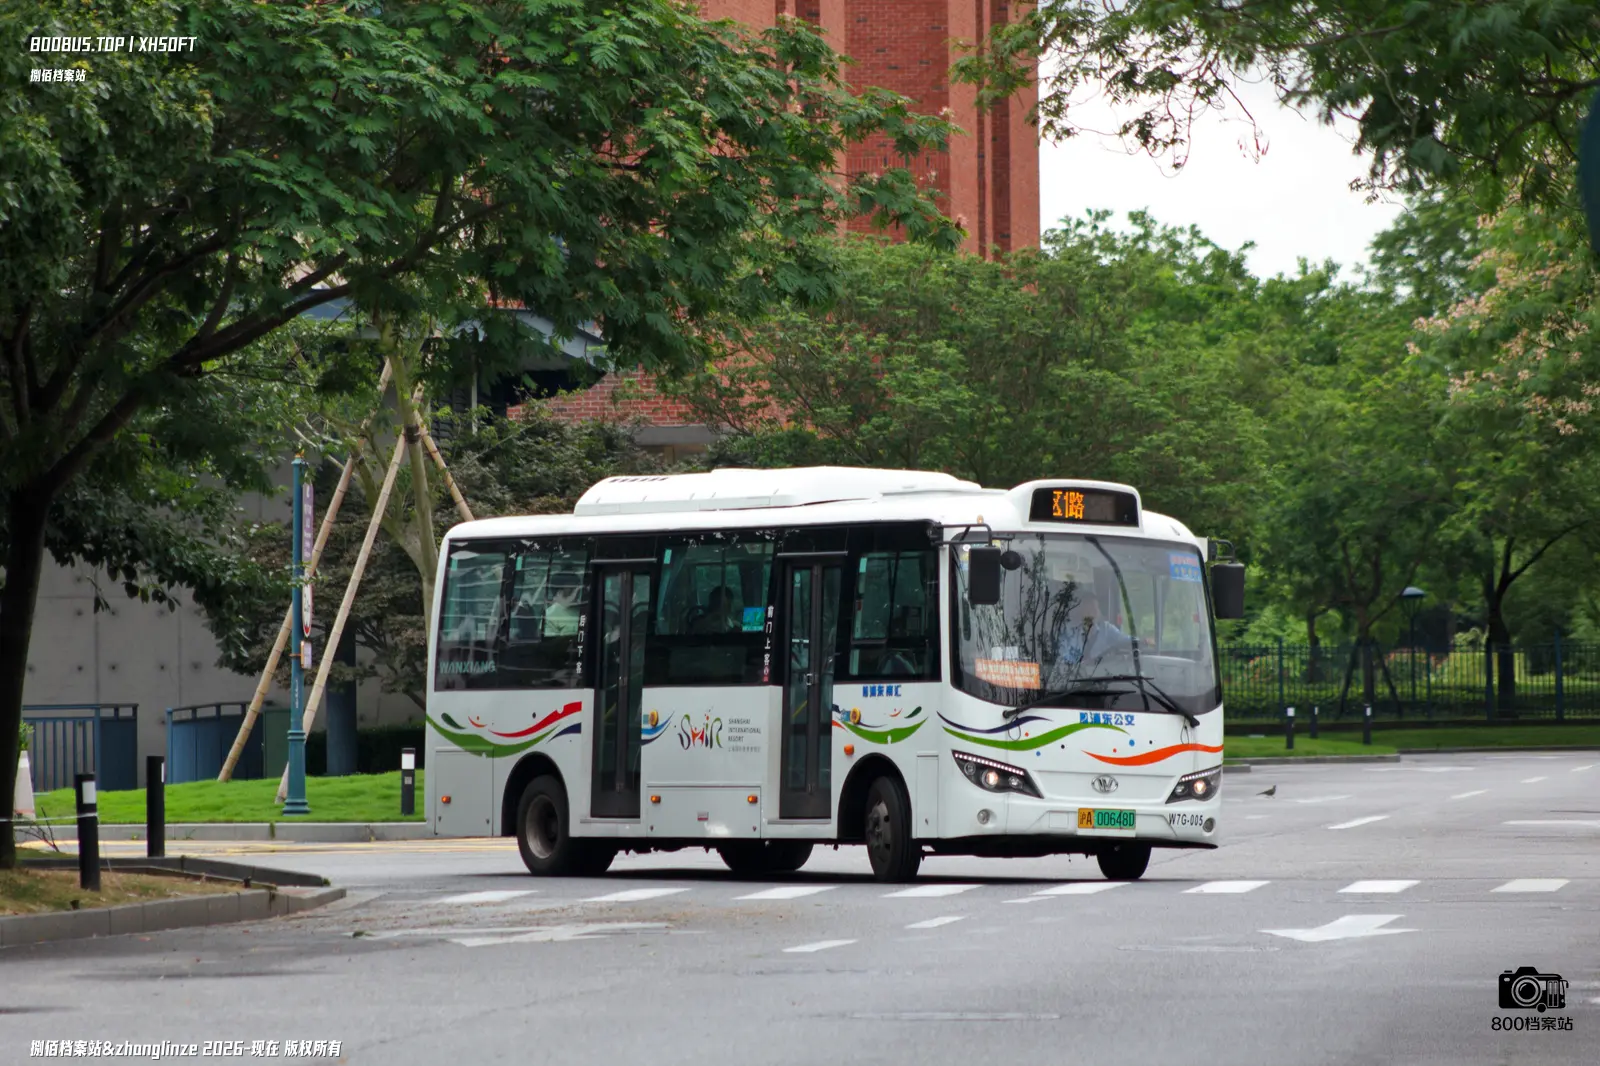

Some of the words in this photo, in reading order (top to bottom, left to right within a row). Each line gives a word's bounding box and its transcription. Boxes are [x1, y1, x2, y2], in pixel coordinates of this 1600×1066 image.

[440, 660, 496, 674] WANXIANG
[1097, 811, 1135, 827] 00648D
[1168, 812, 1204, 827] W7G-005
